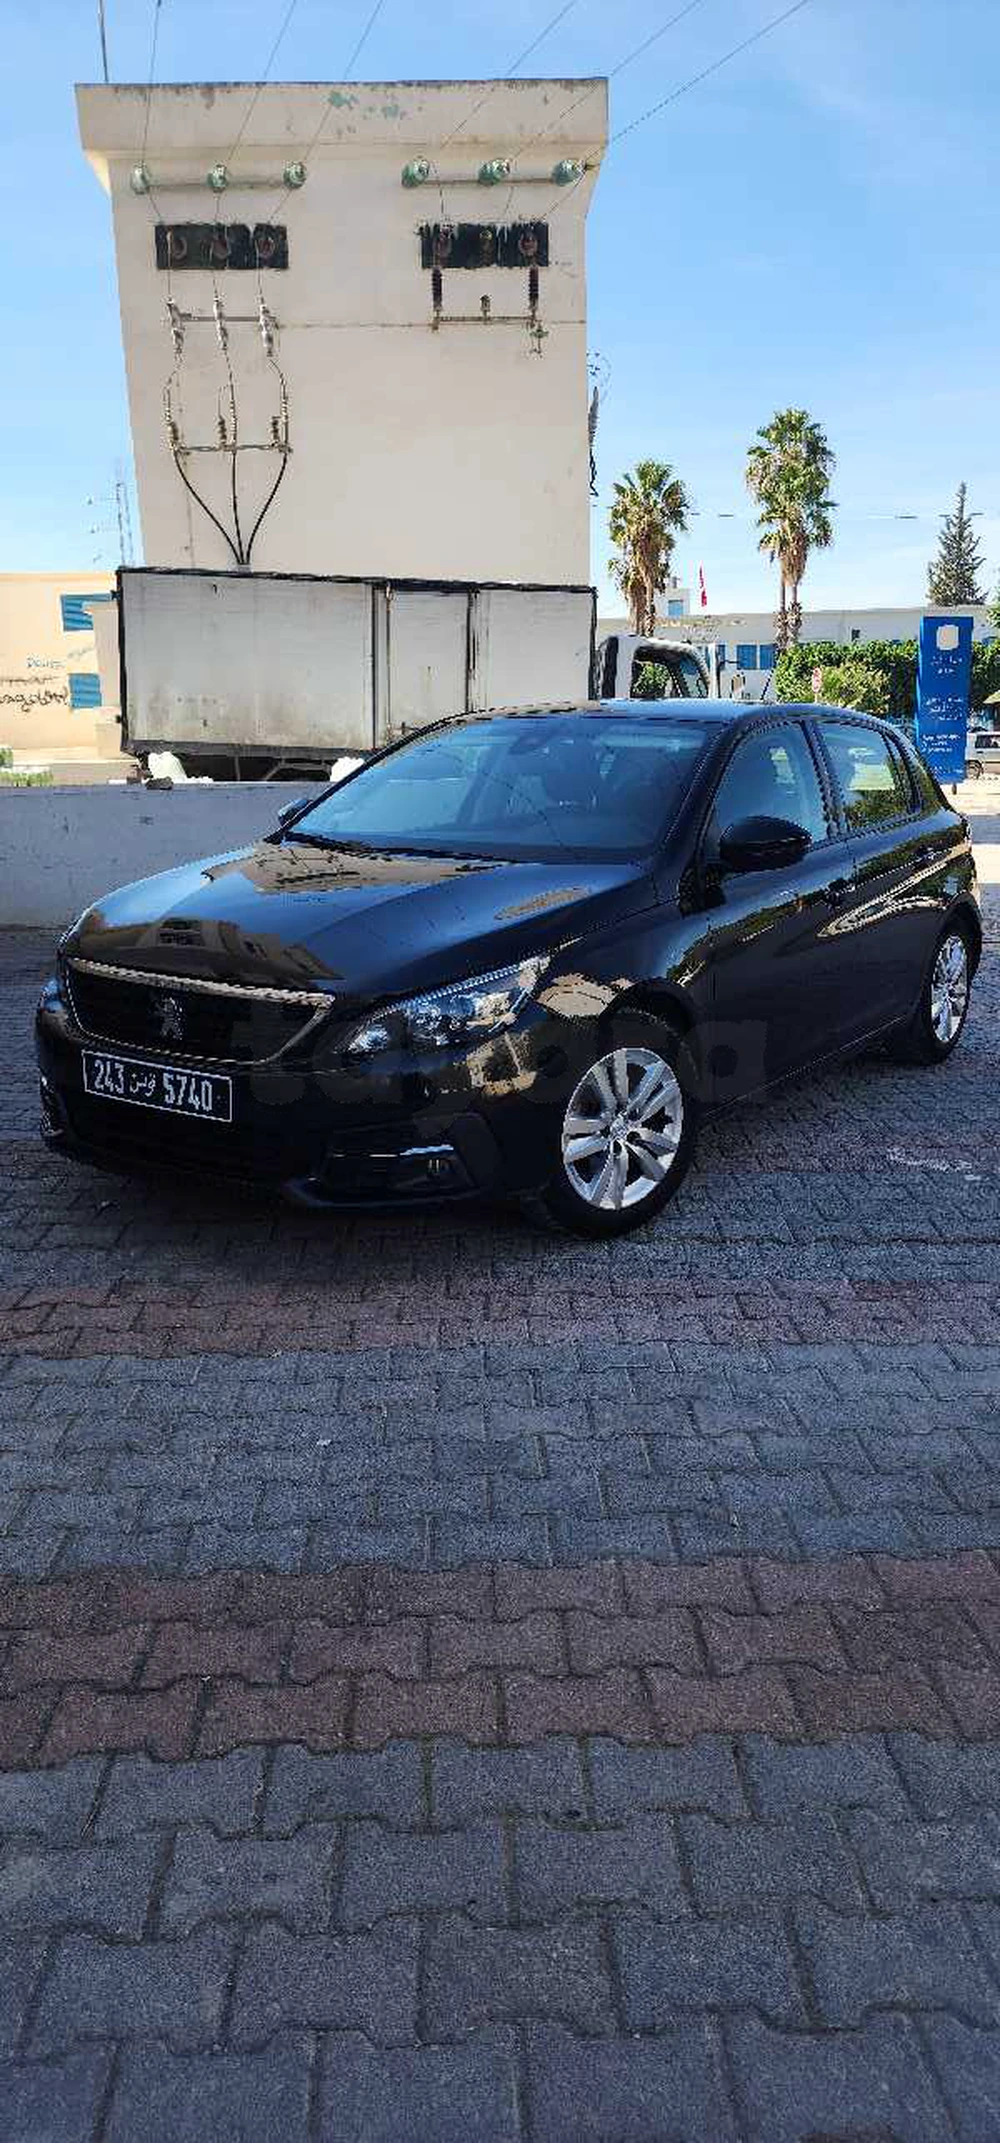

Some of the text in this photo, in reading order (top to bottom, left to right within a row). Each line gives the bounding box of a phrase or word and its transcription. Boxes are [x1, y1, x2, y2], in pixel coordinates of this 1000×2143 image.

[95, 1059, 213, 1112] 243 تونس 5740
